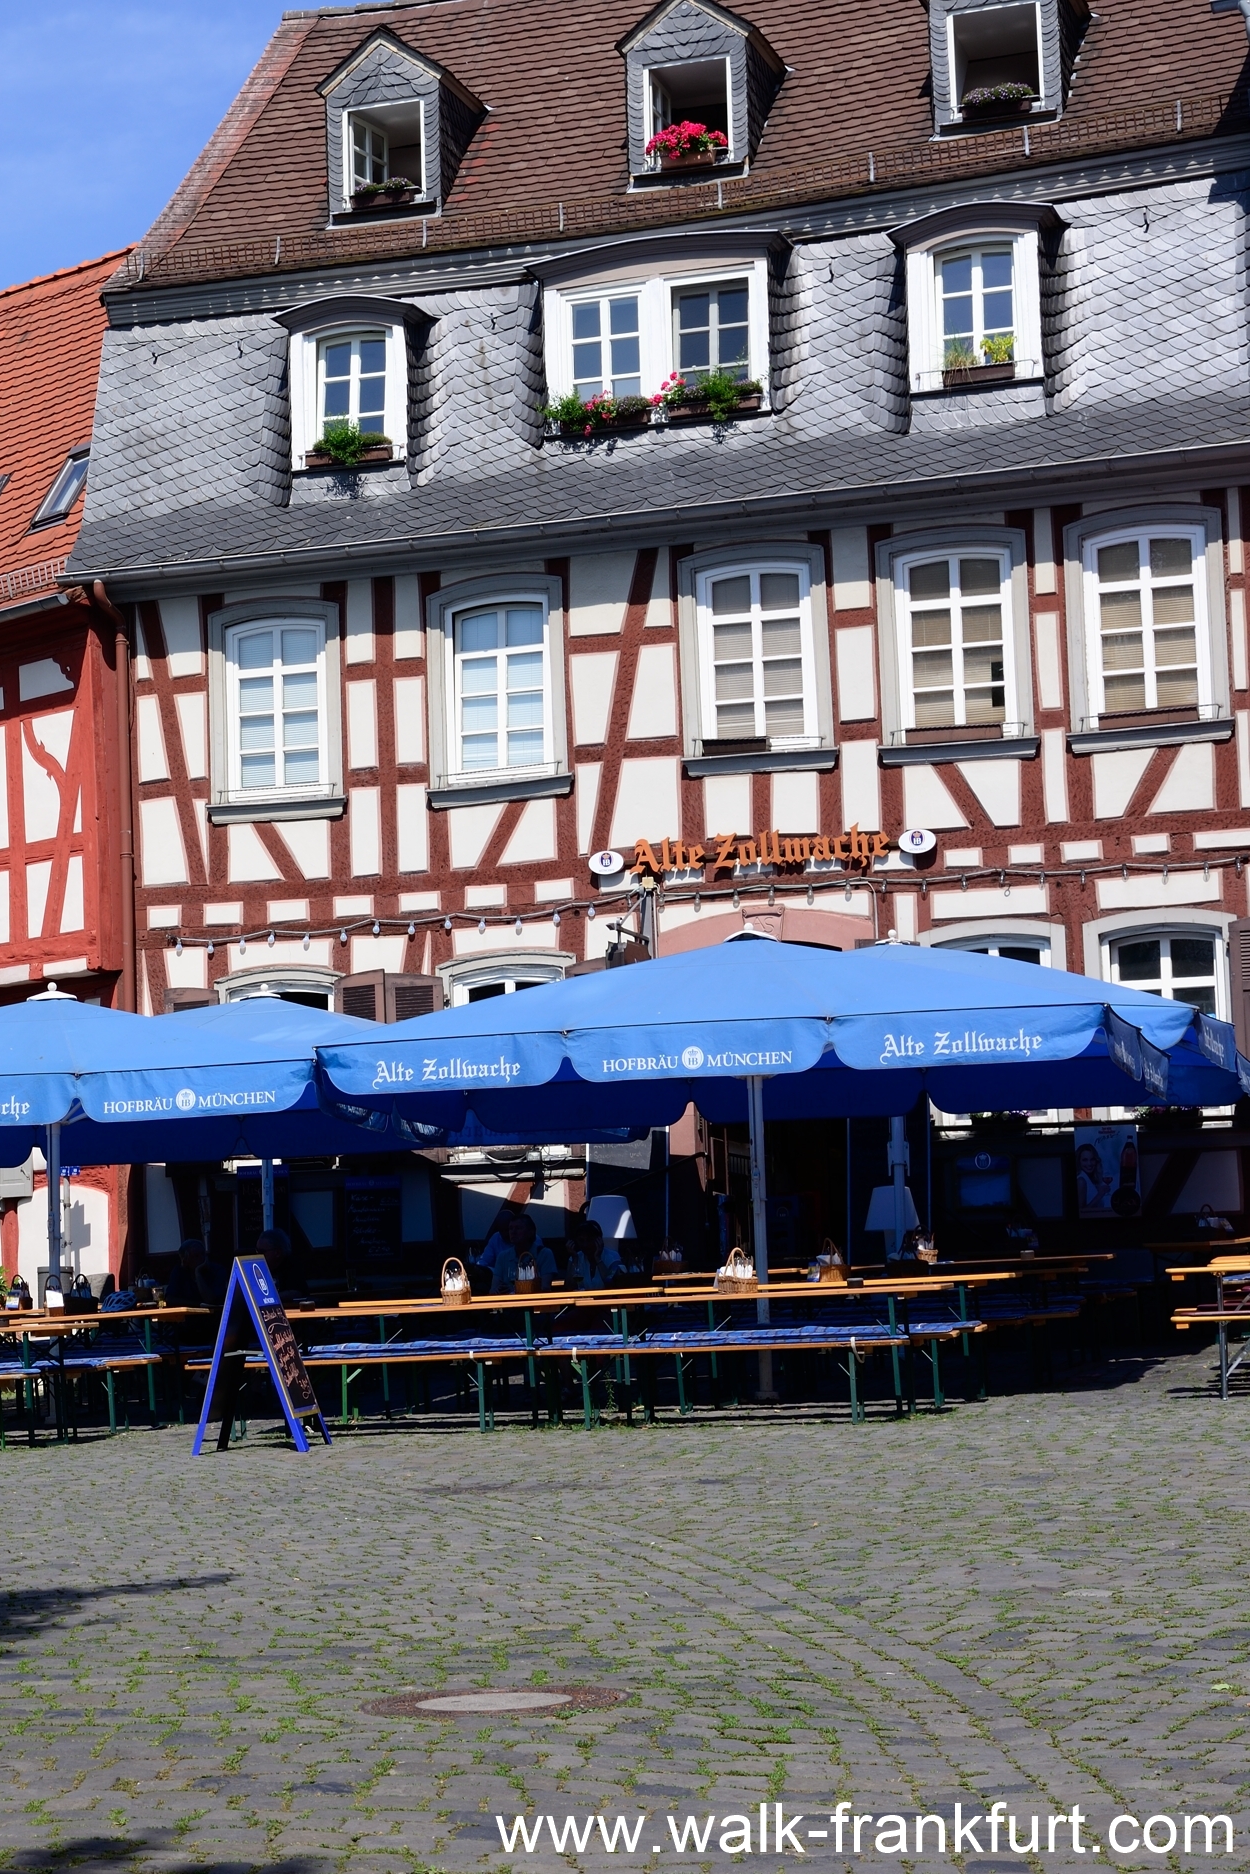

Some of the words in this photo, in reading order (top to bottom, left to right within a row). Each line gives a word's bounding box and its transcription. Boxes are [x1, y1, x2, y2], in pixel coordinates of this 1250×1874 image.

[630, 836, 705, 875] Alte
[713, 822, 891, 869] Zollwache
[602, 1054, 678, 1073] HOFBRÄU
[707, 1050, 792, 1068] MÜNCHEN
[879, 1033, 925, 1065] Alte
[933, 1028, 1042, 1057] Zollwache
[372, 1060, 414, 1090] Alte
[422, 1055, 521, 1083] Zollwache
[104, 1096, 173, 1114] HOFBRÄU
[198, 1090, 275, 1108] MÜNCHEN
